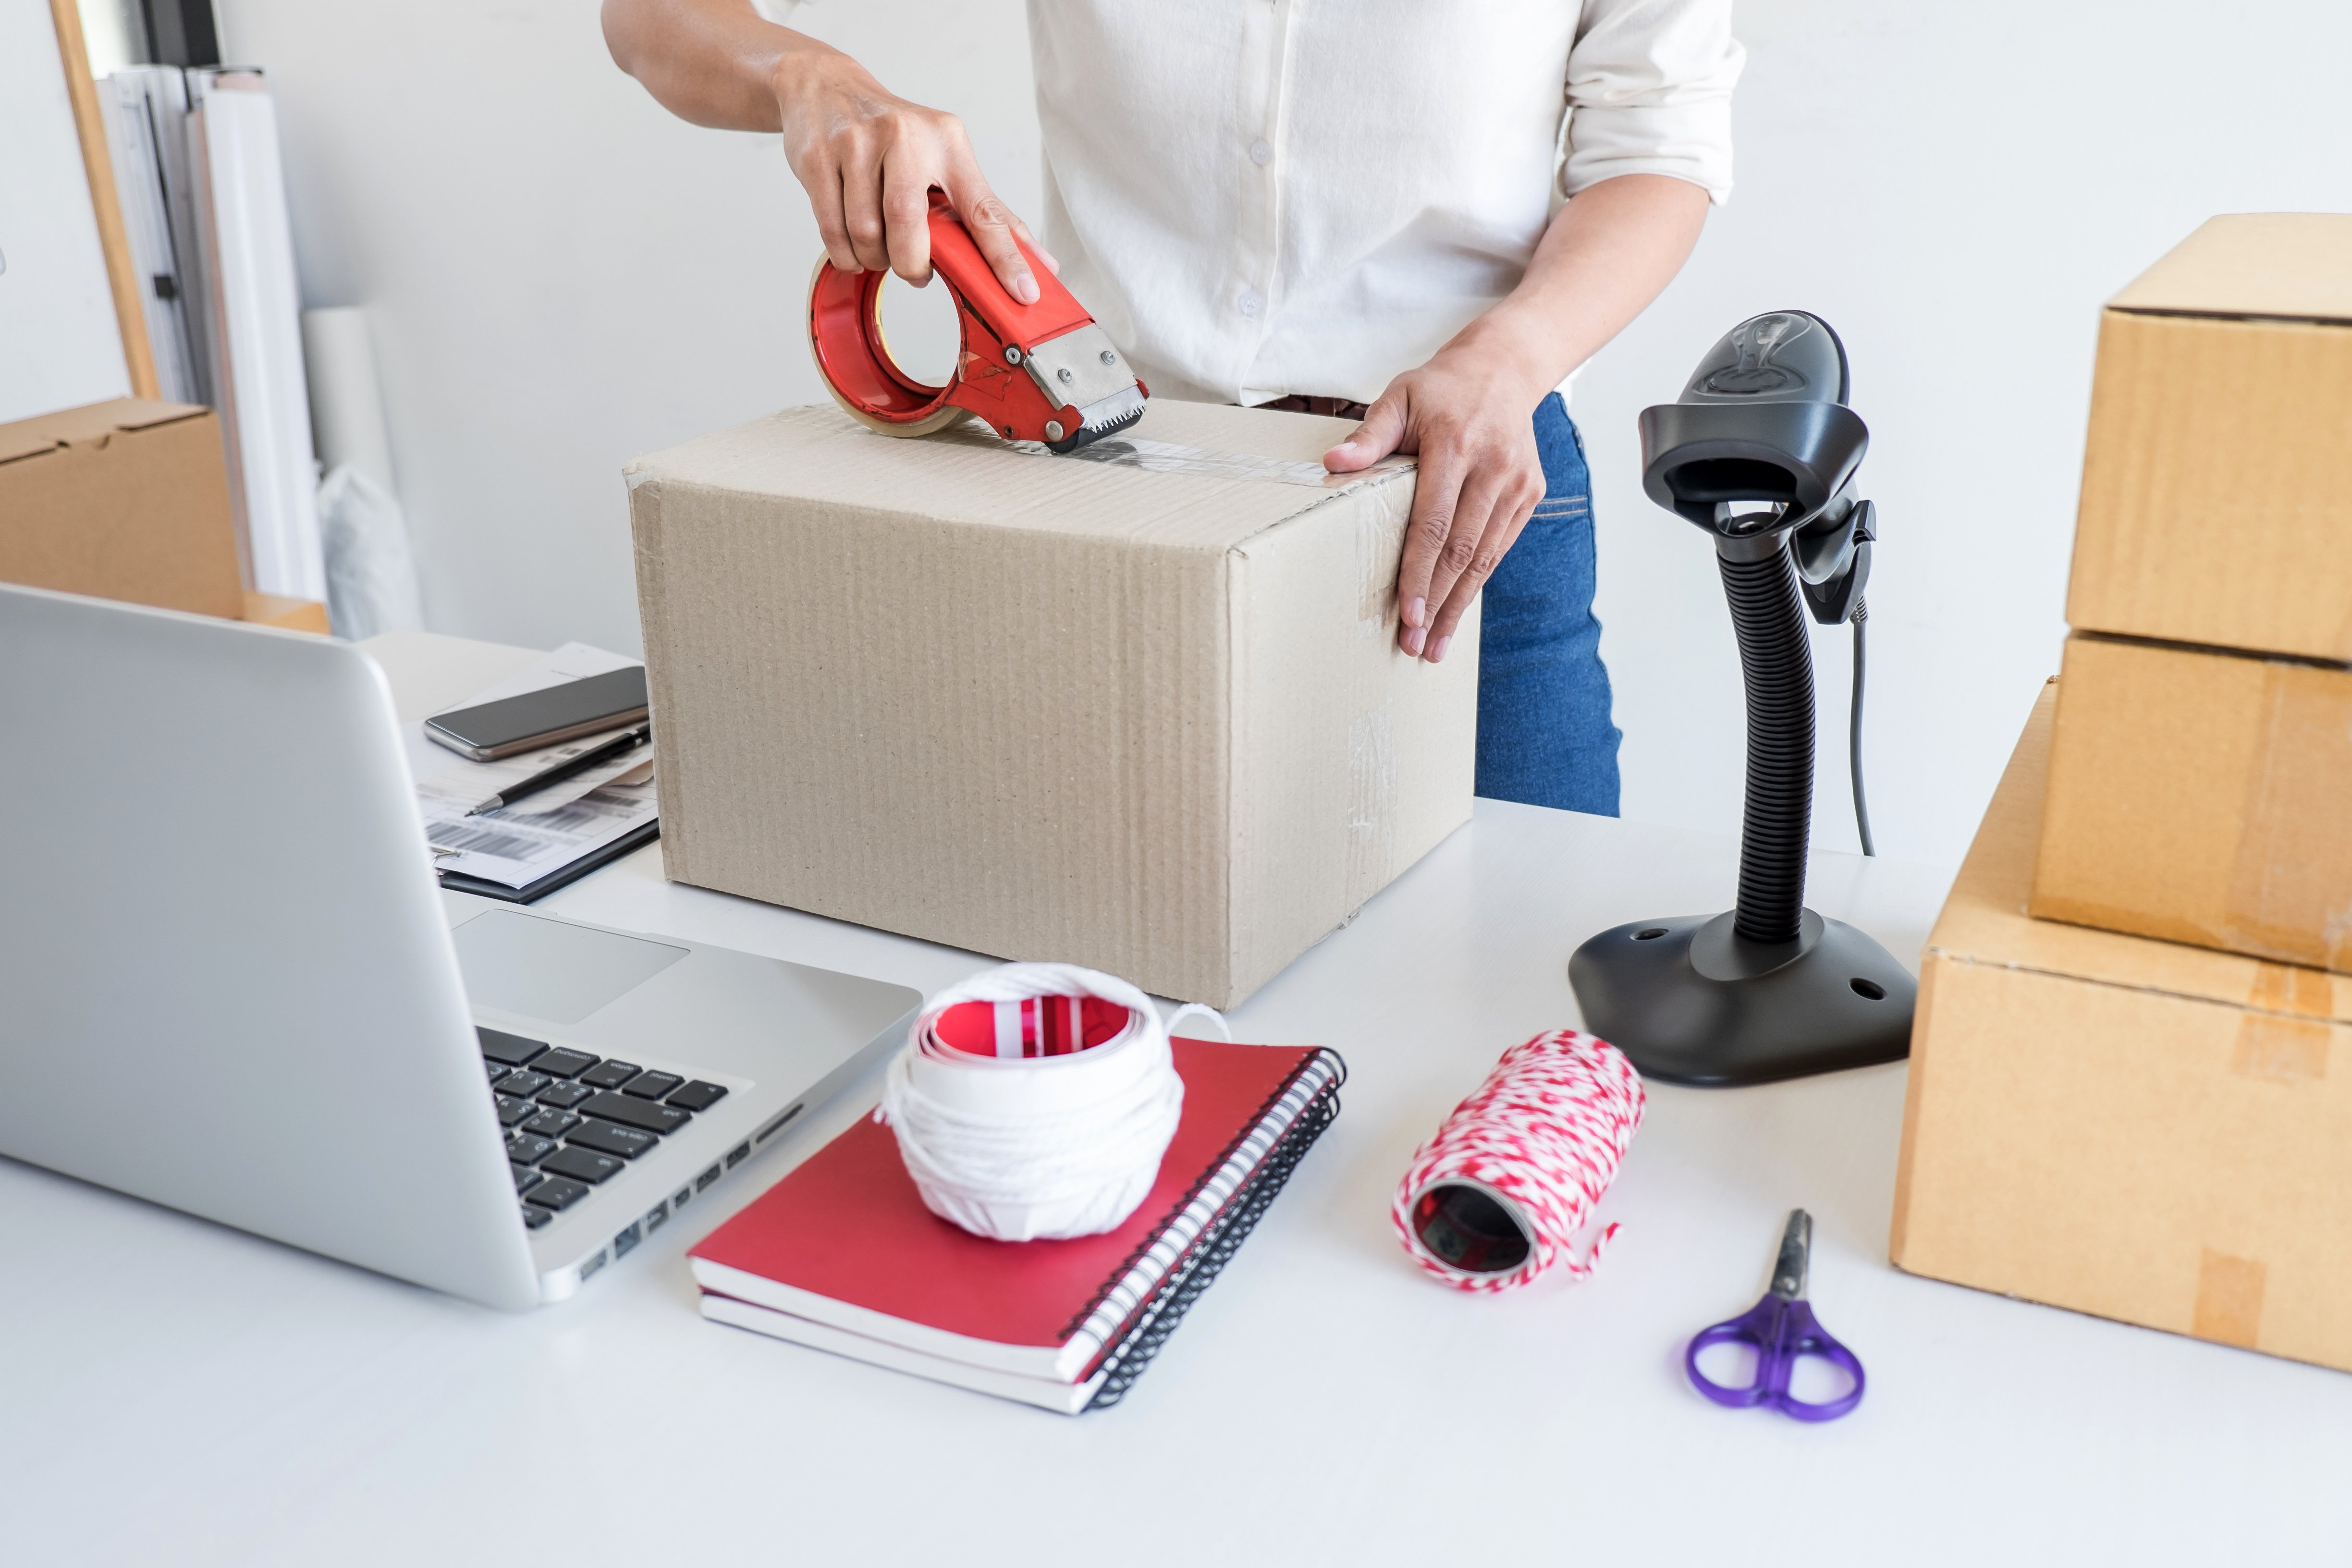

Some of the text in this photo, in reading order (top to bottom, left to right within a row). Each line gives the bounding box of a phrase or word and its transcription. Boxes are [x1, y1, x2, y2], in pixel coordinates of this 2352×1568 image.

[554, 1048, 590, 1060] command
[610, 1062, 634, 1071] option
[650, 1072, 676, 1081] control
[530, 1077, 544, 1086] X
[573, 1087, 587, 1096] Z
[518, 1104, 530, 1114] S
[662, 1109, 681, 1117] shift
[561, 1115, 575, 1125] A
[612, 1128, 648, 1141] caps lock
[535, 1142, 548, 1151] Q
[599, 1158, 613, 1167] tab
